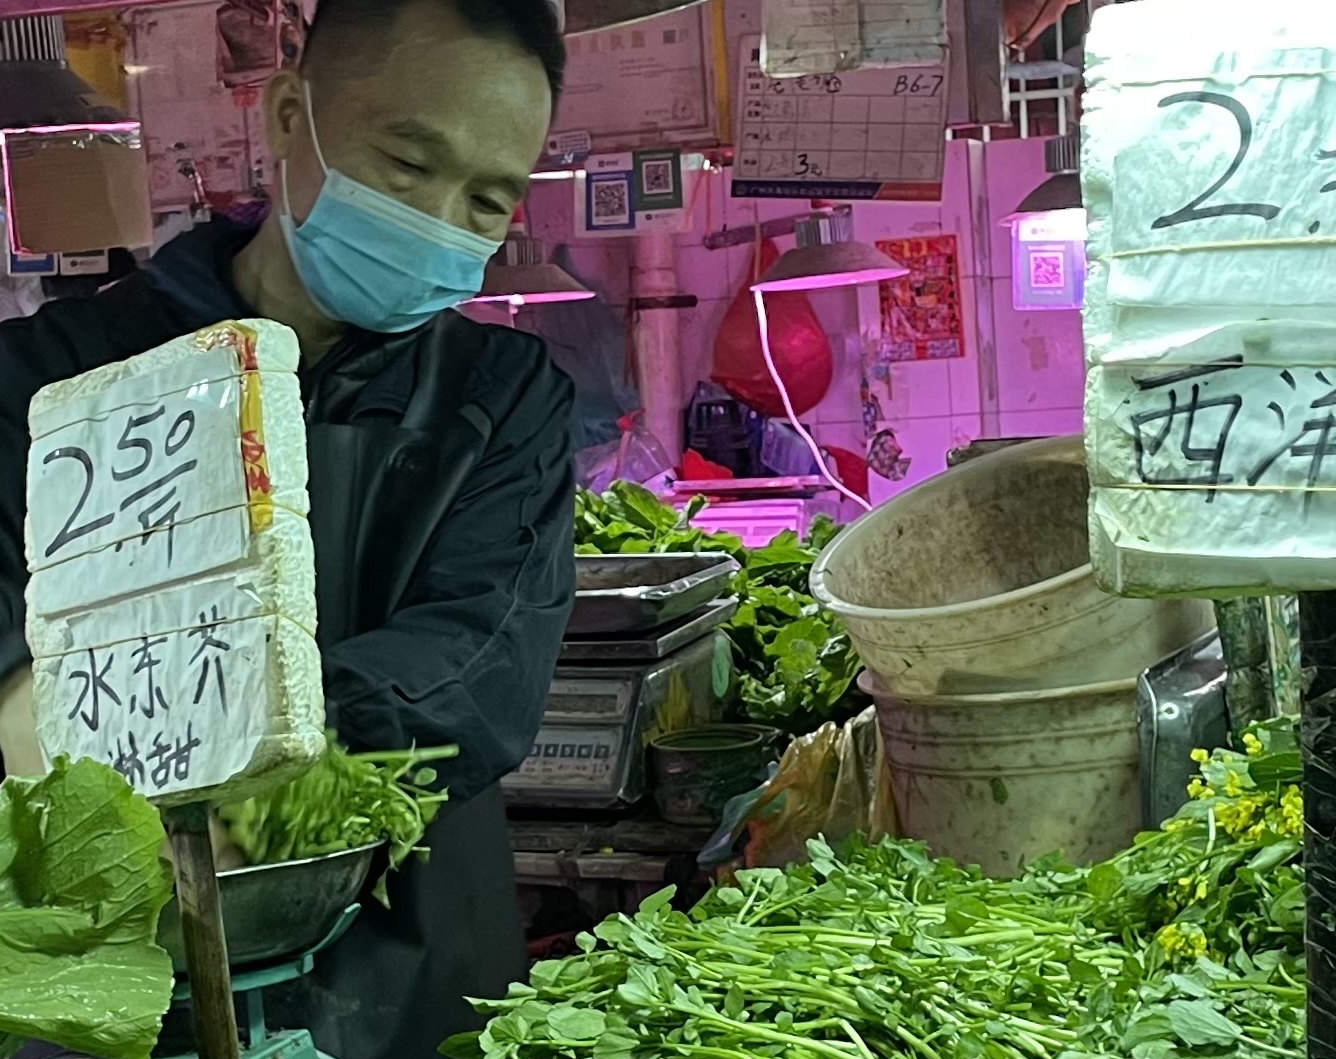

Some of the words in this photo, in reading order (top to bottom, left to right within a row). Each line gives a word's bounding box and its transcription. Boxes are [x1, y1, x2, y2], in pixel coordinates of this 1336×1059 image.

[138, 485, 182, 569] 斤
[67, 605, 231, 731] 水东芥
